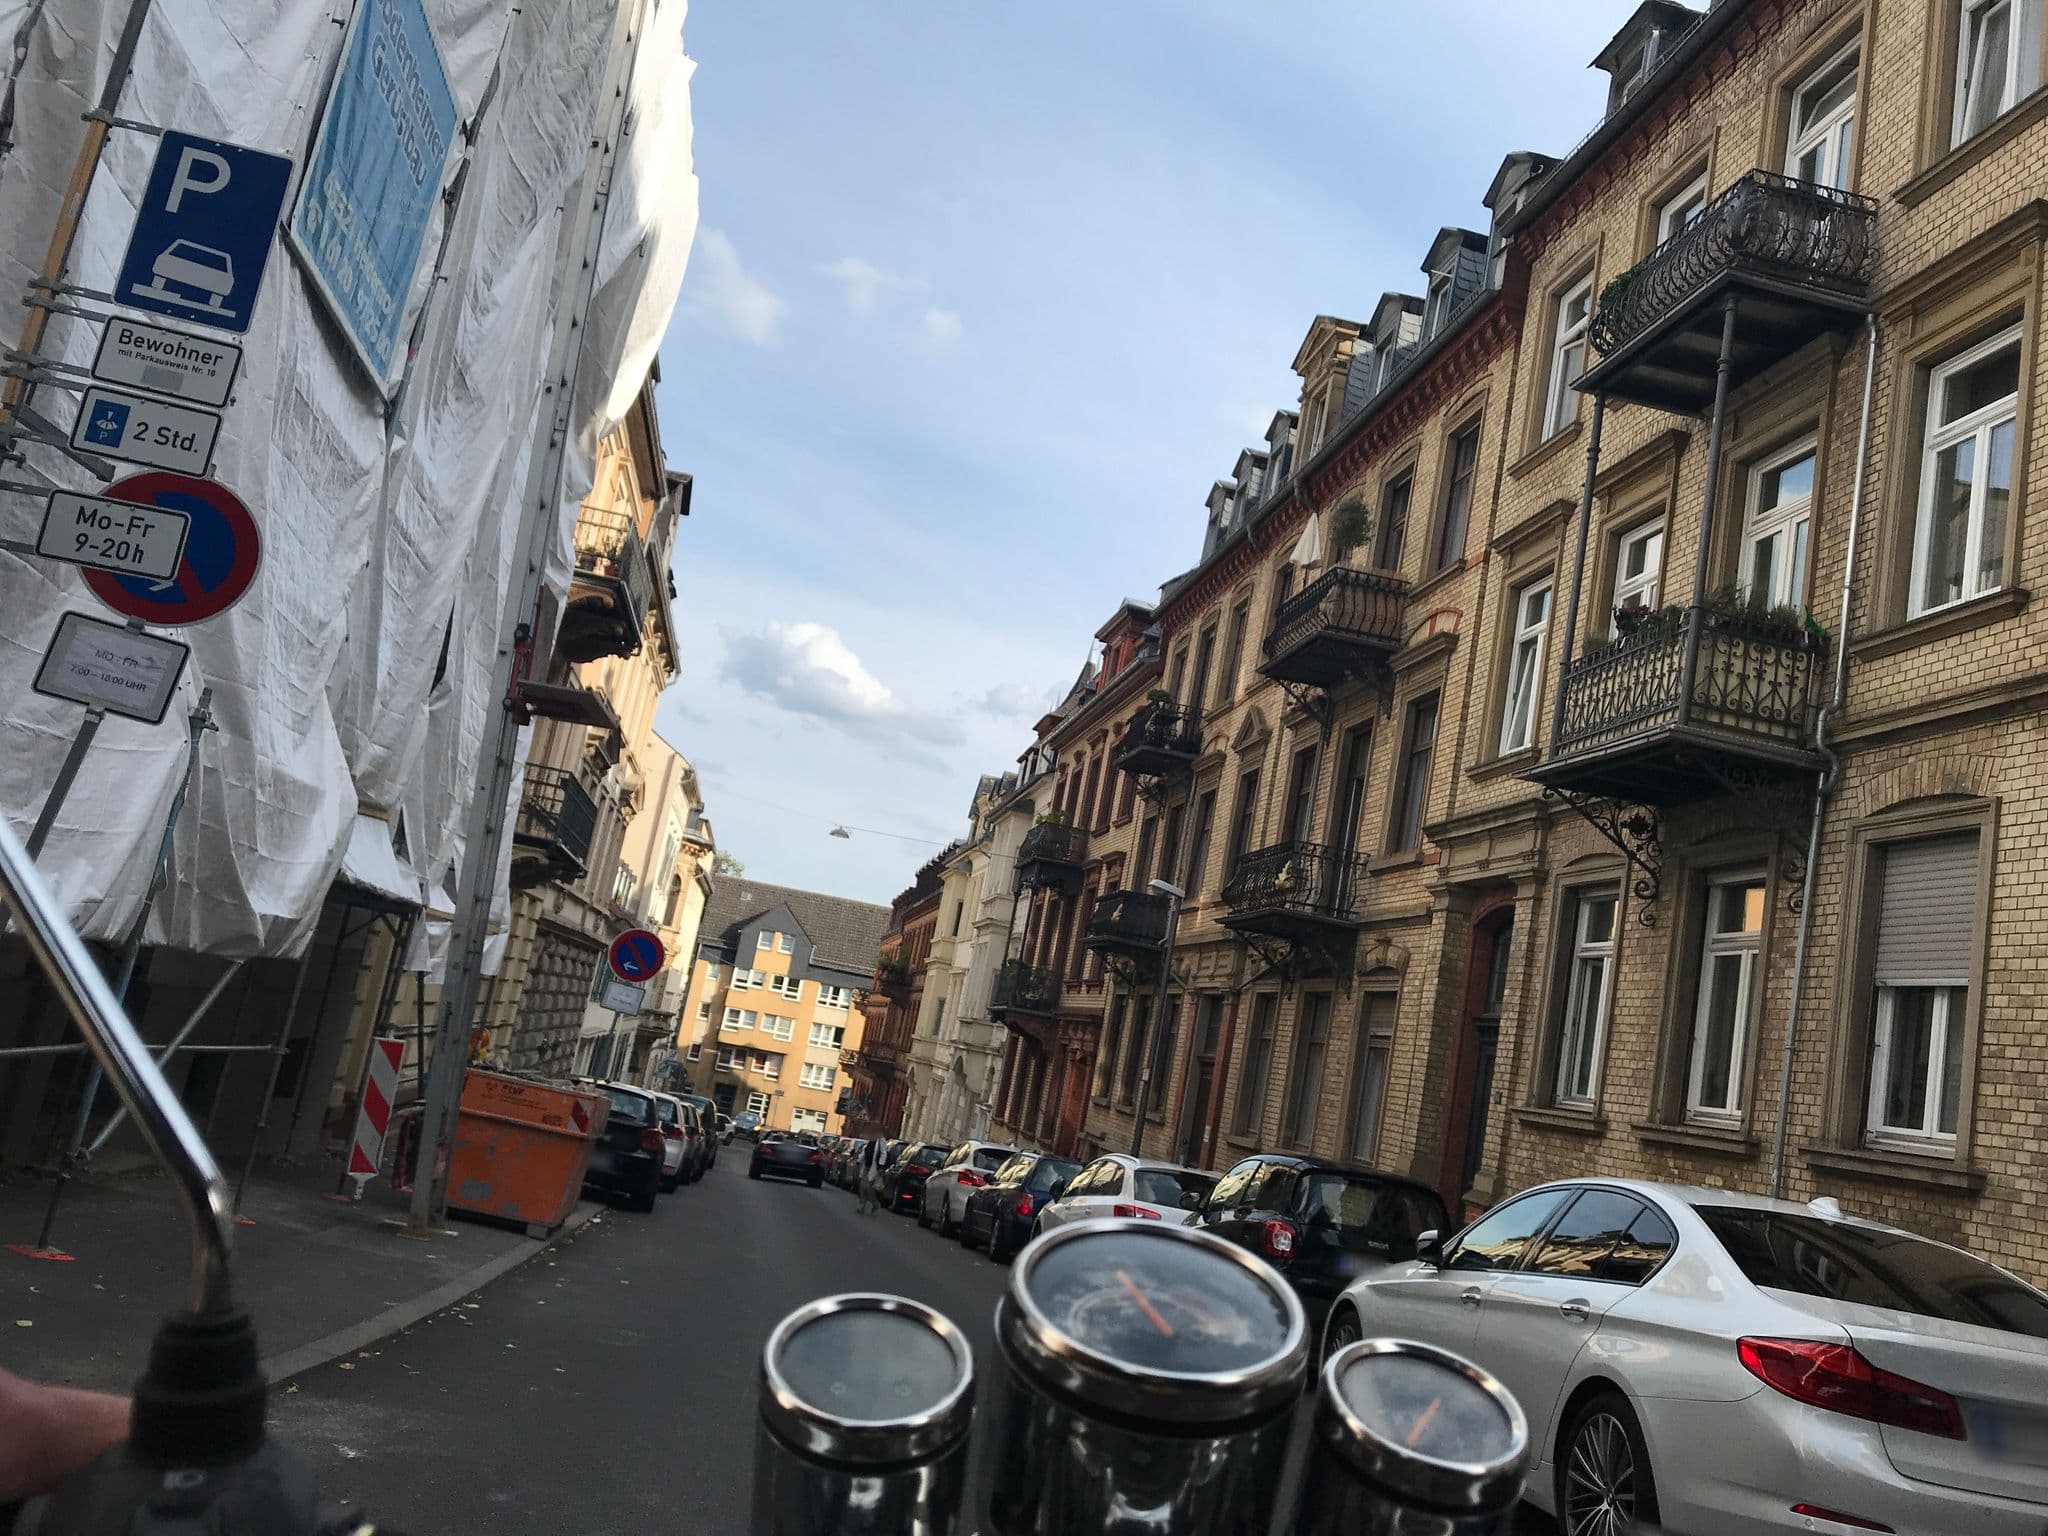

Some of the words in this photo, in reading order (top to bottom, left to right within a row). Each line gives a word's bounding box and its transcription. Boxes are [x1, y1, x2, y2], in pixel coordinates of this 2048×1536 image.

[378, 0, 445, 166] odenheimer
[165, 146, 231, 213] P
[118, 328, 223, 366] Bewohner
[118, 349, 133, 359] mit
[135, 353, 188, 371] Parkausweis
[191, 365, 204, 376] Nr.
[133, 422, 149, 442] 2
[154, 426, 198, 453] Std.
[76, 505, 155, 538] Mo-Fr
[125, 680, 147, 692] UHR
